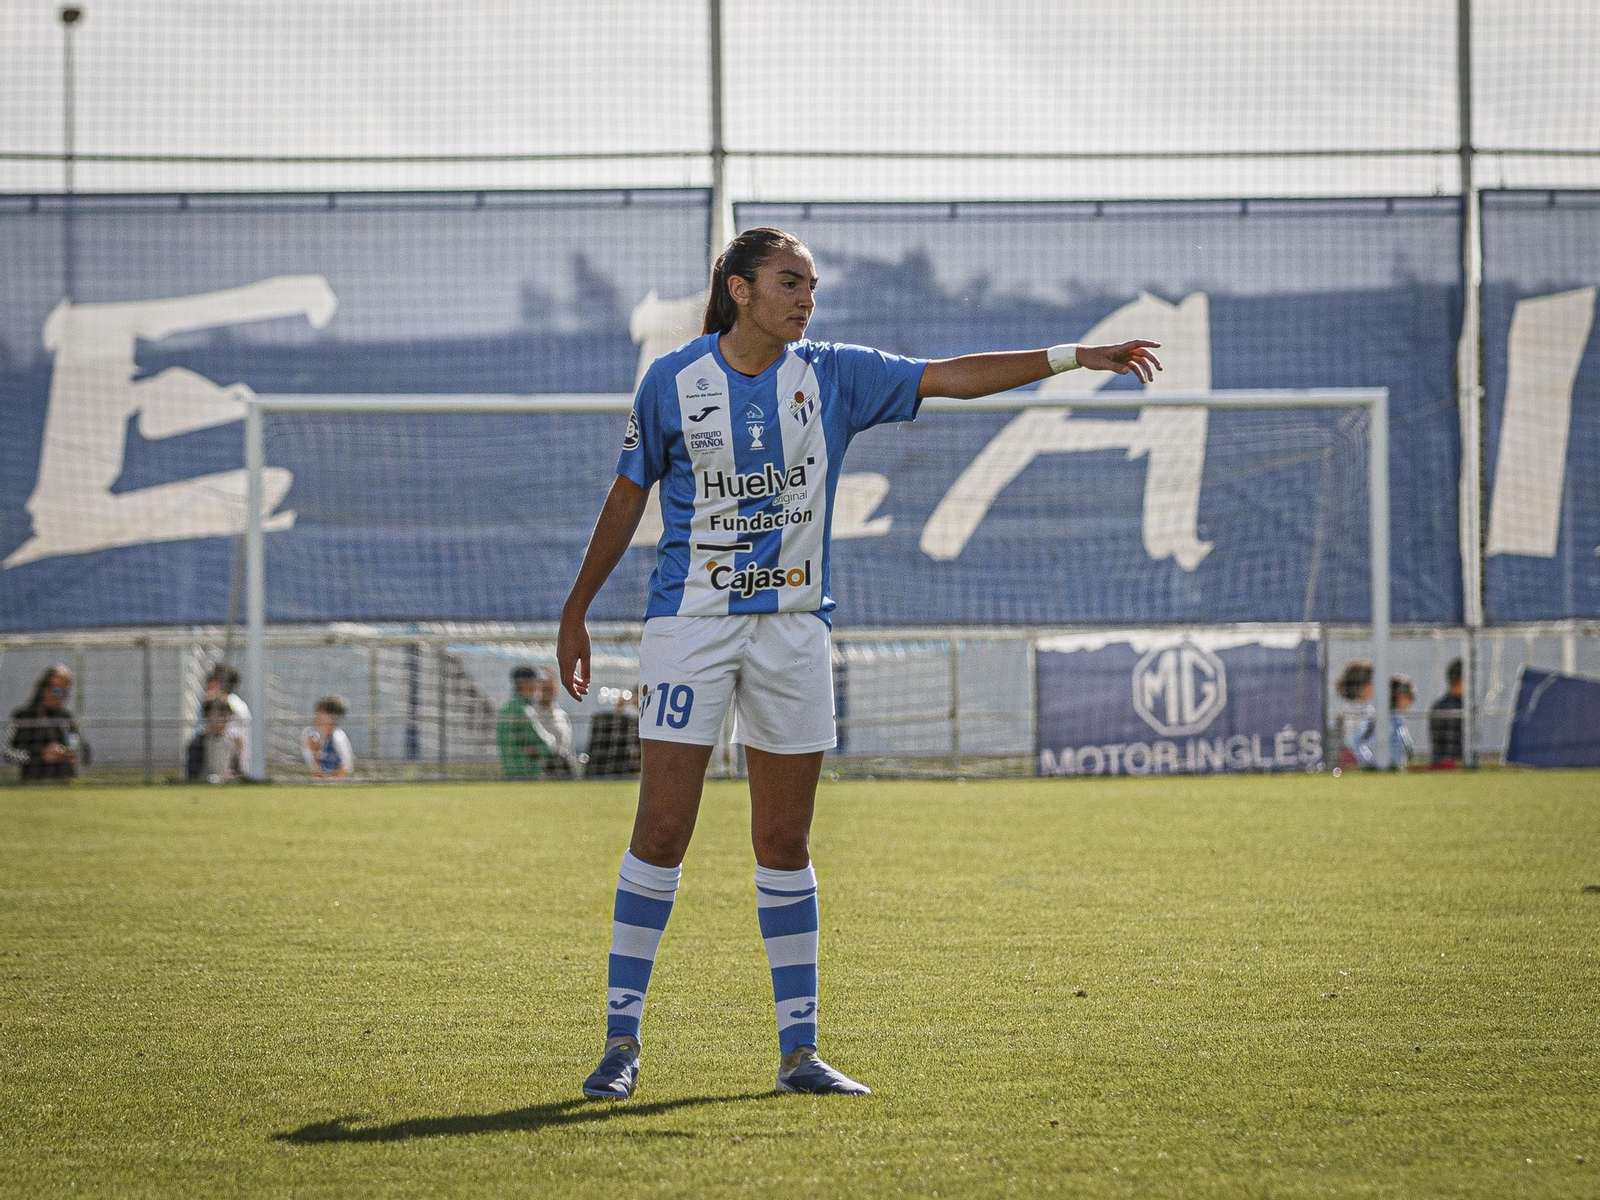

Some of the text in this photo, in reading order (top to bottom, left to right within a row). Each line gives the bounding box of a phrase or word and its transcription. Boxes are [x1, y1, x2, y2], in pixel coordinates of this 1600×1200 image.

[690, 430, 722, 440] INSTITUTO
[690, 438, 724, 448] ESPAÑOL
[703, 465, 806, 498] Huelva
[774, 490, 808, 505] original
[710, 507, 812, 531] Fundación
[711, 560, 810, 596] Cajasol
[1143, 649, 1217, 725] MG
[656, 682, 694, 729] 19
[1039, 724, 1322, 775] MOTOR INGLÉS
